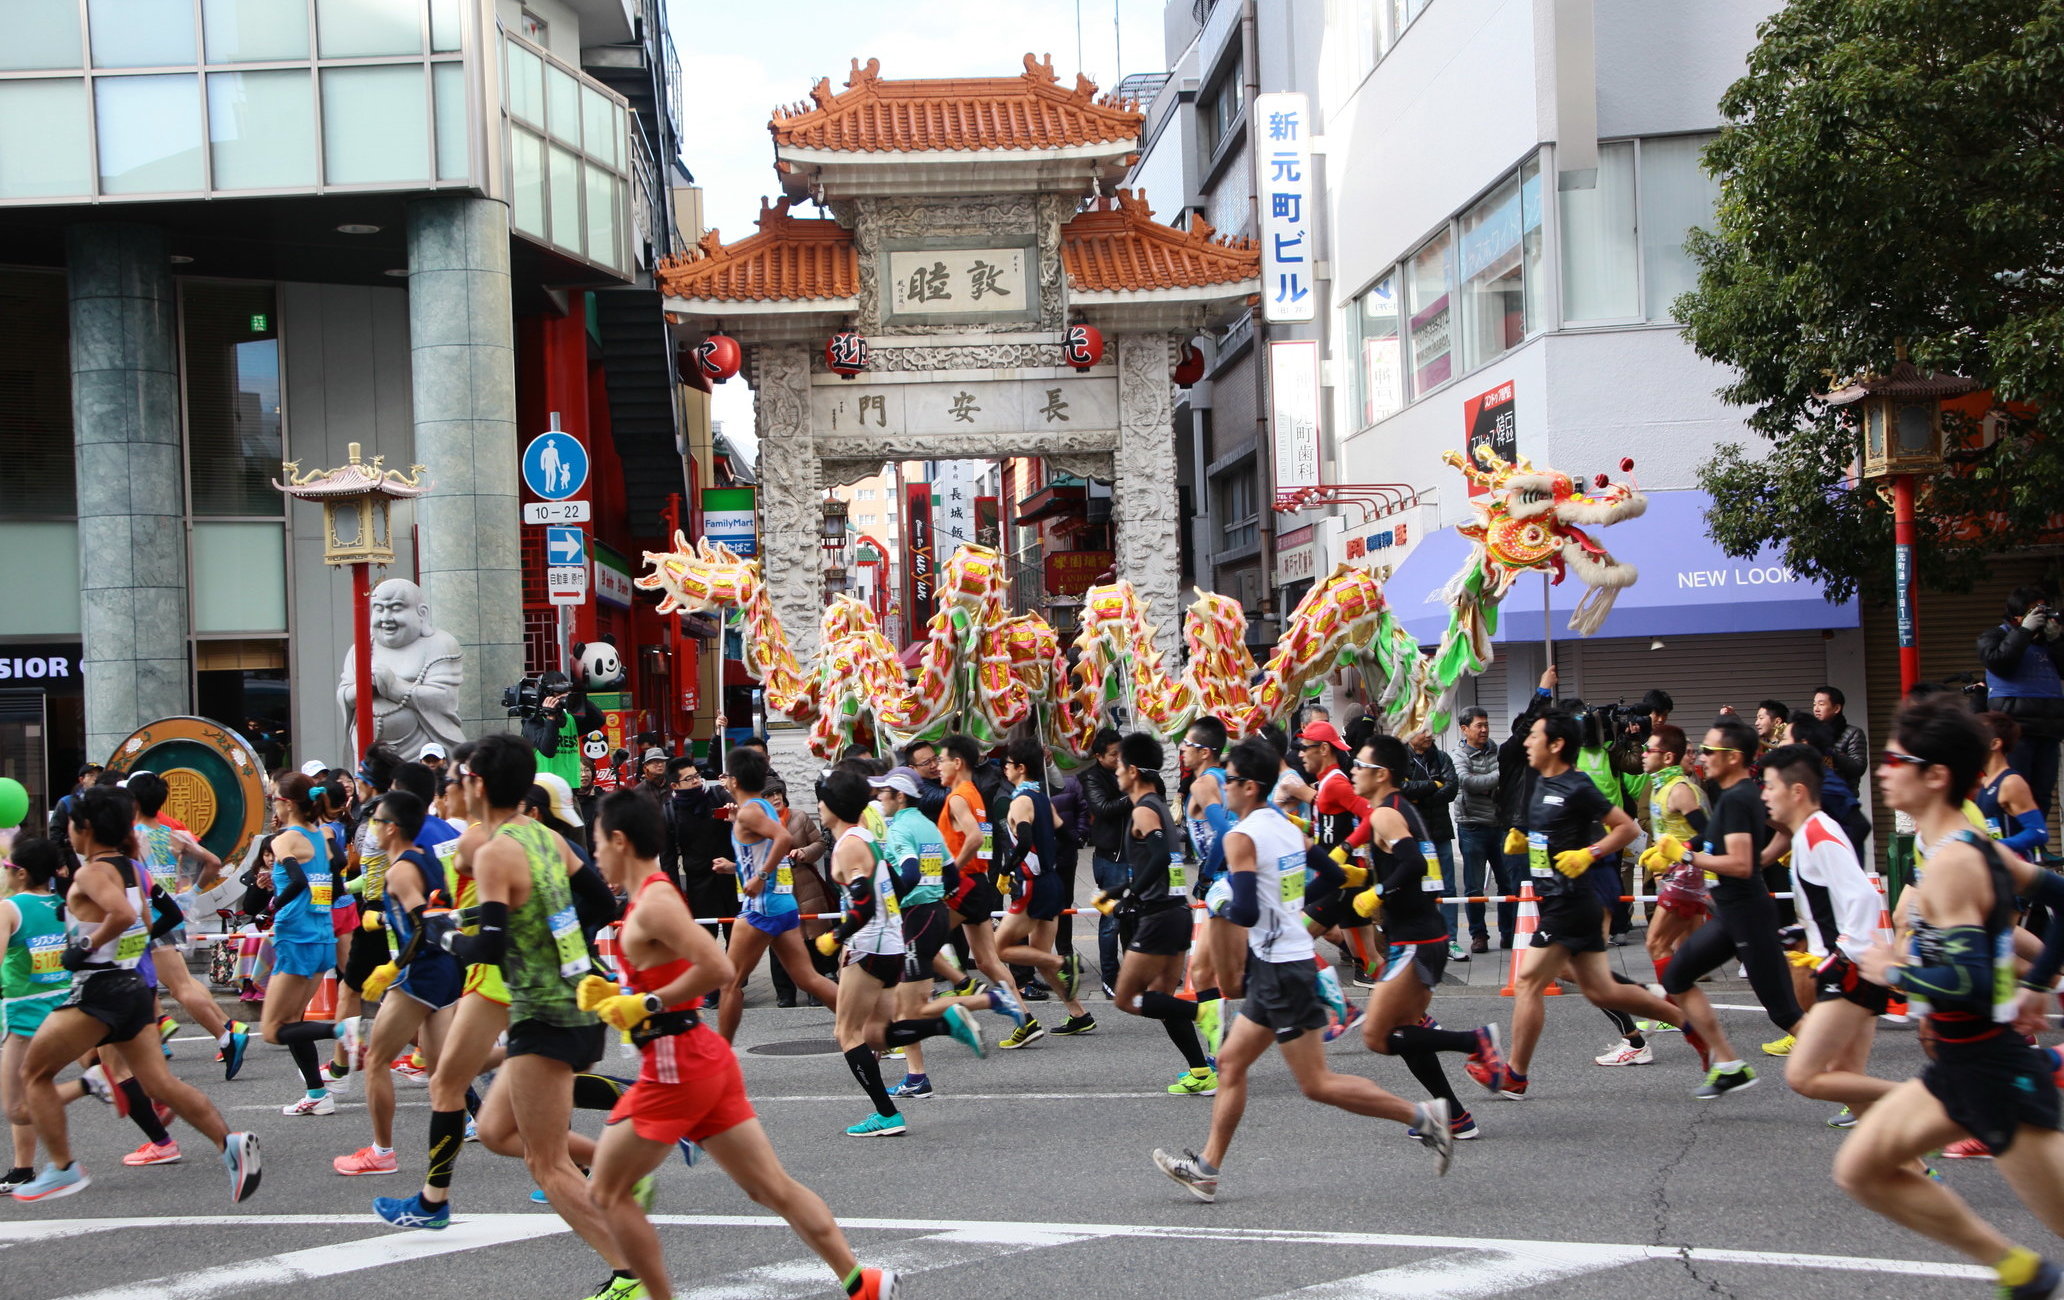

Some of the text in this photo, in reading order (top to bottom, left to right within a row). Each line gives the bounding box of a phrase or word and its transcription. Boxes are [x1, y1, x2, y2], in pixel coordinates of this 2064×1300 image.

[1269, 111, 1308, 303] 新元町ビル
[705, 519, 753, 530] FamilyMart
[951, 487, 964, 556] 長城飯
[1678, 567, 1796, 589] NEW LOOK
[557, 734, 578, 748] RESS
